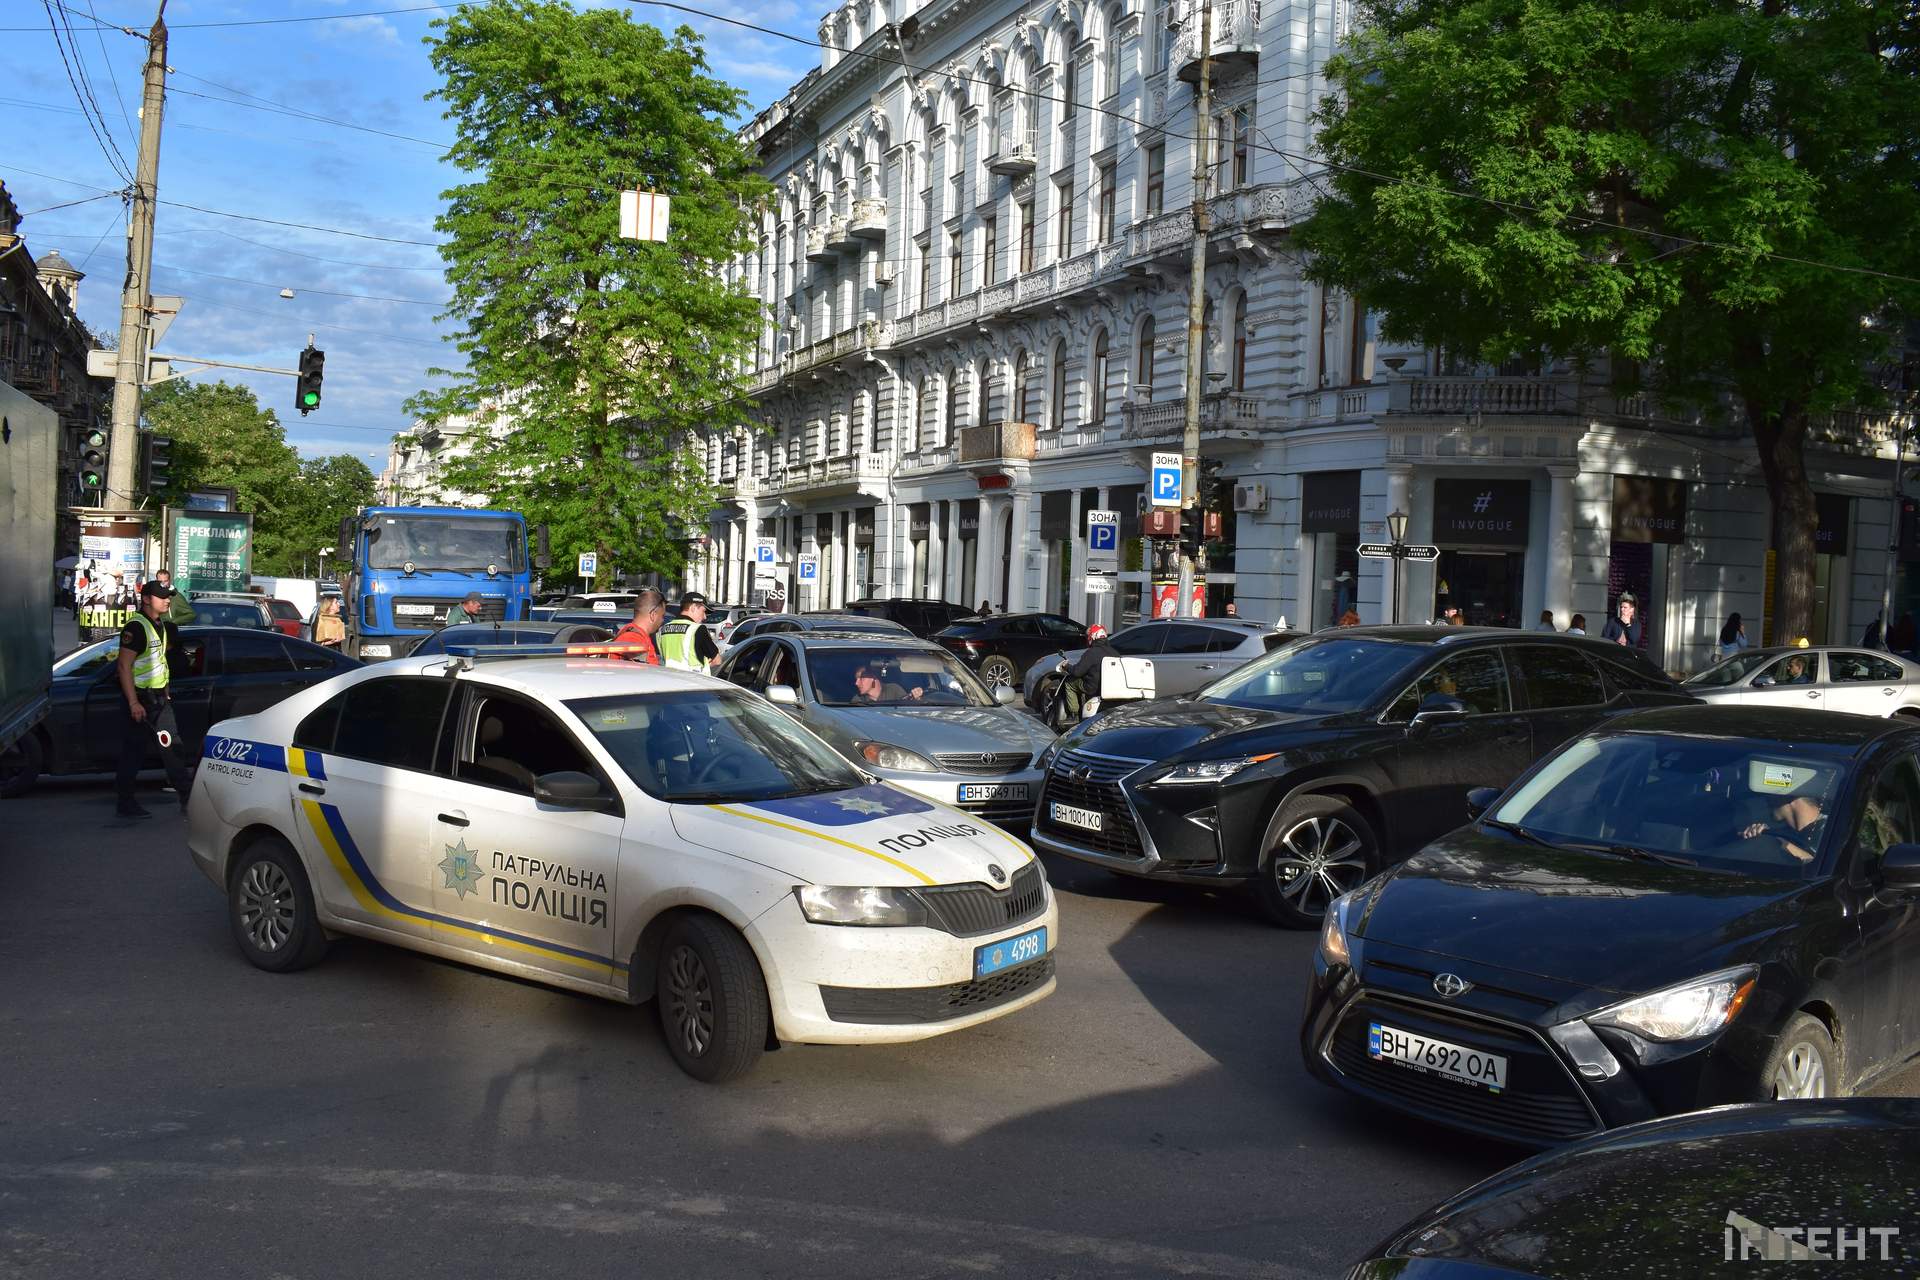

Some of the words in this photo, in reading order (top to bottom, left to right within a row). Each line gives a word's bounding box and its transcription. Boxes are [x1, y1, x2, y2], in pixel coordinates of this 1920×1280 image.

[1156, 456, 1179, 465] ЗОНА
[1090, 513, 1118, 523] ЗОНА
[1451, 519, 1513, 531] INVOGUE
[190, 526, 242, 539] РЕКЛАМА
[177, 526, 190, 579] ЗОВНІШНЯ
[226, 741, 252, 760] 102
[207, 762, 230, 775] PATROL
[231, 767, 254, 779] POLICE
[985, 787, 1009, 798] 3049
[1069, 809, 1086, 826] 1001
[879, 824, 986, 854] ПОЛІЦІЯ
[492, 851, 607, 894] ПАТРУЛЬНА
[492, 877, 607, 929] ПОЛІЦІЯ
[1011, 933, 1039, 961] 4998
[1371, 1041, 1380, 1050] UA
[1414, 1039, 1462, 1073] 7692
